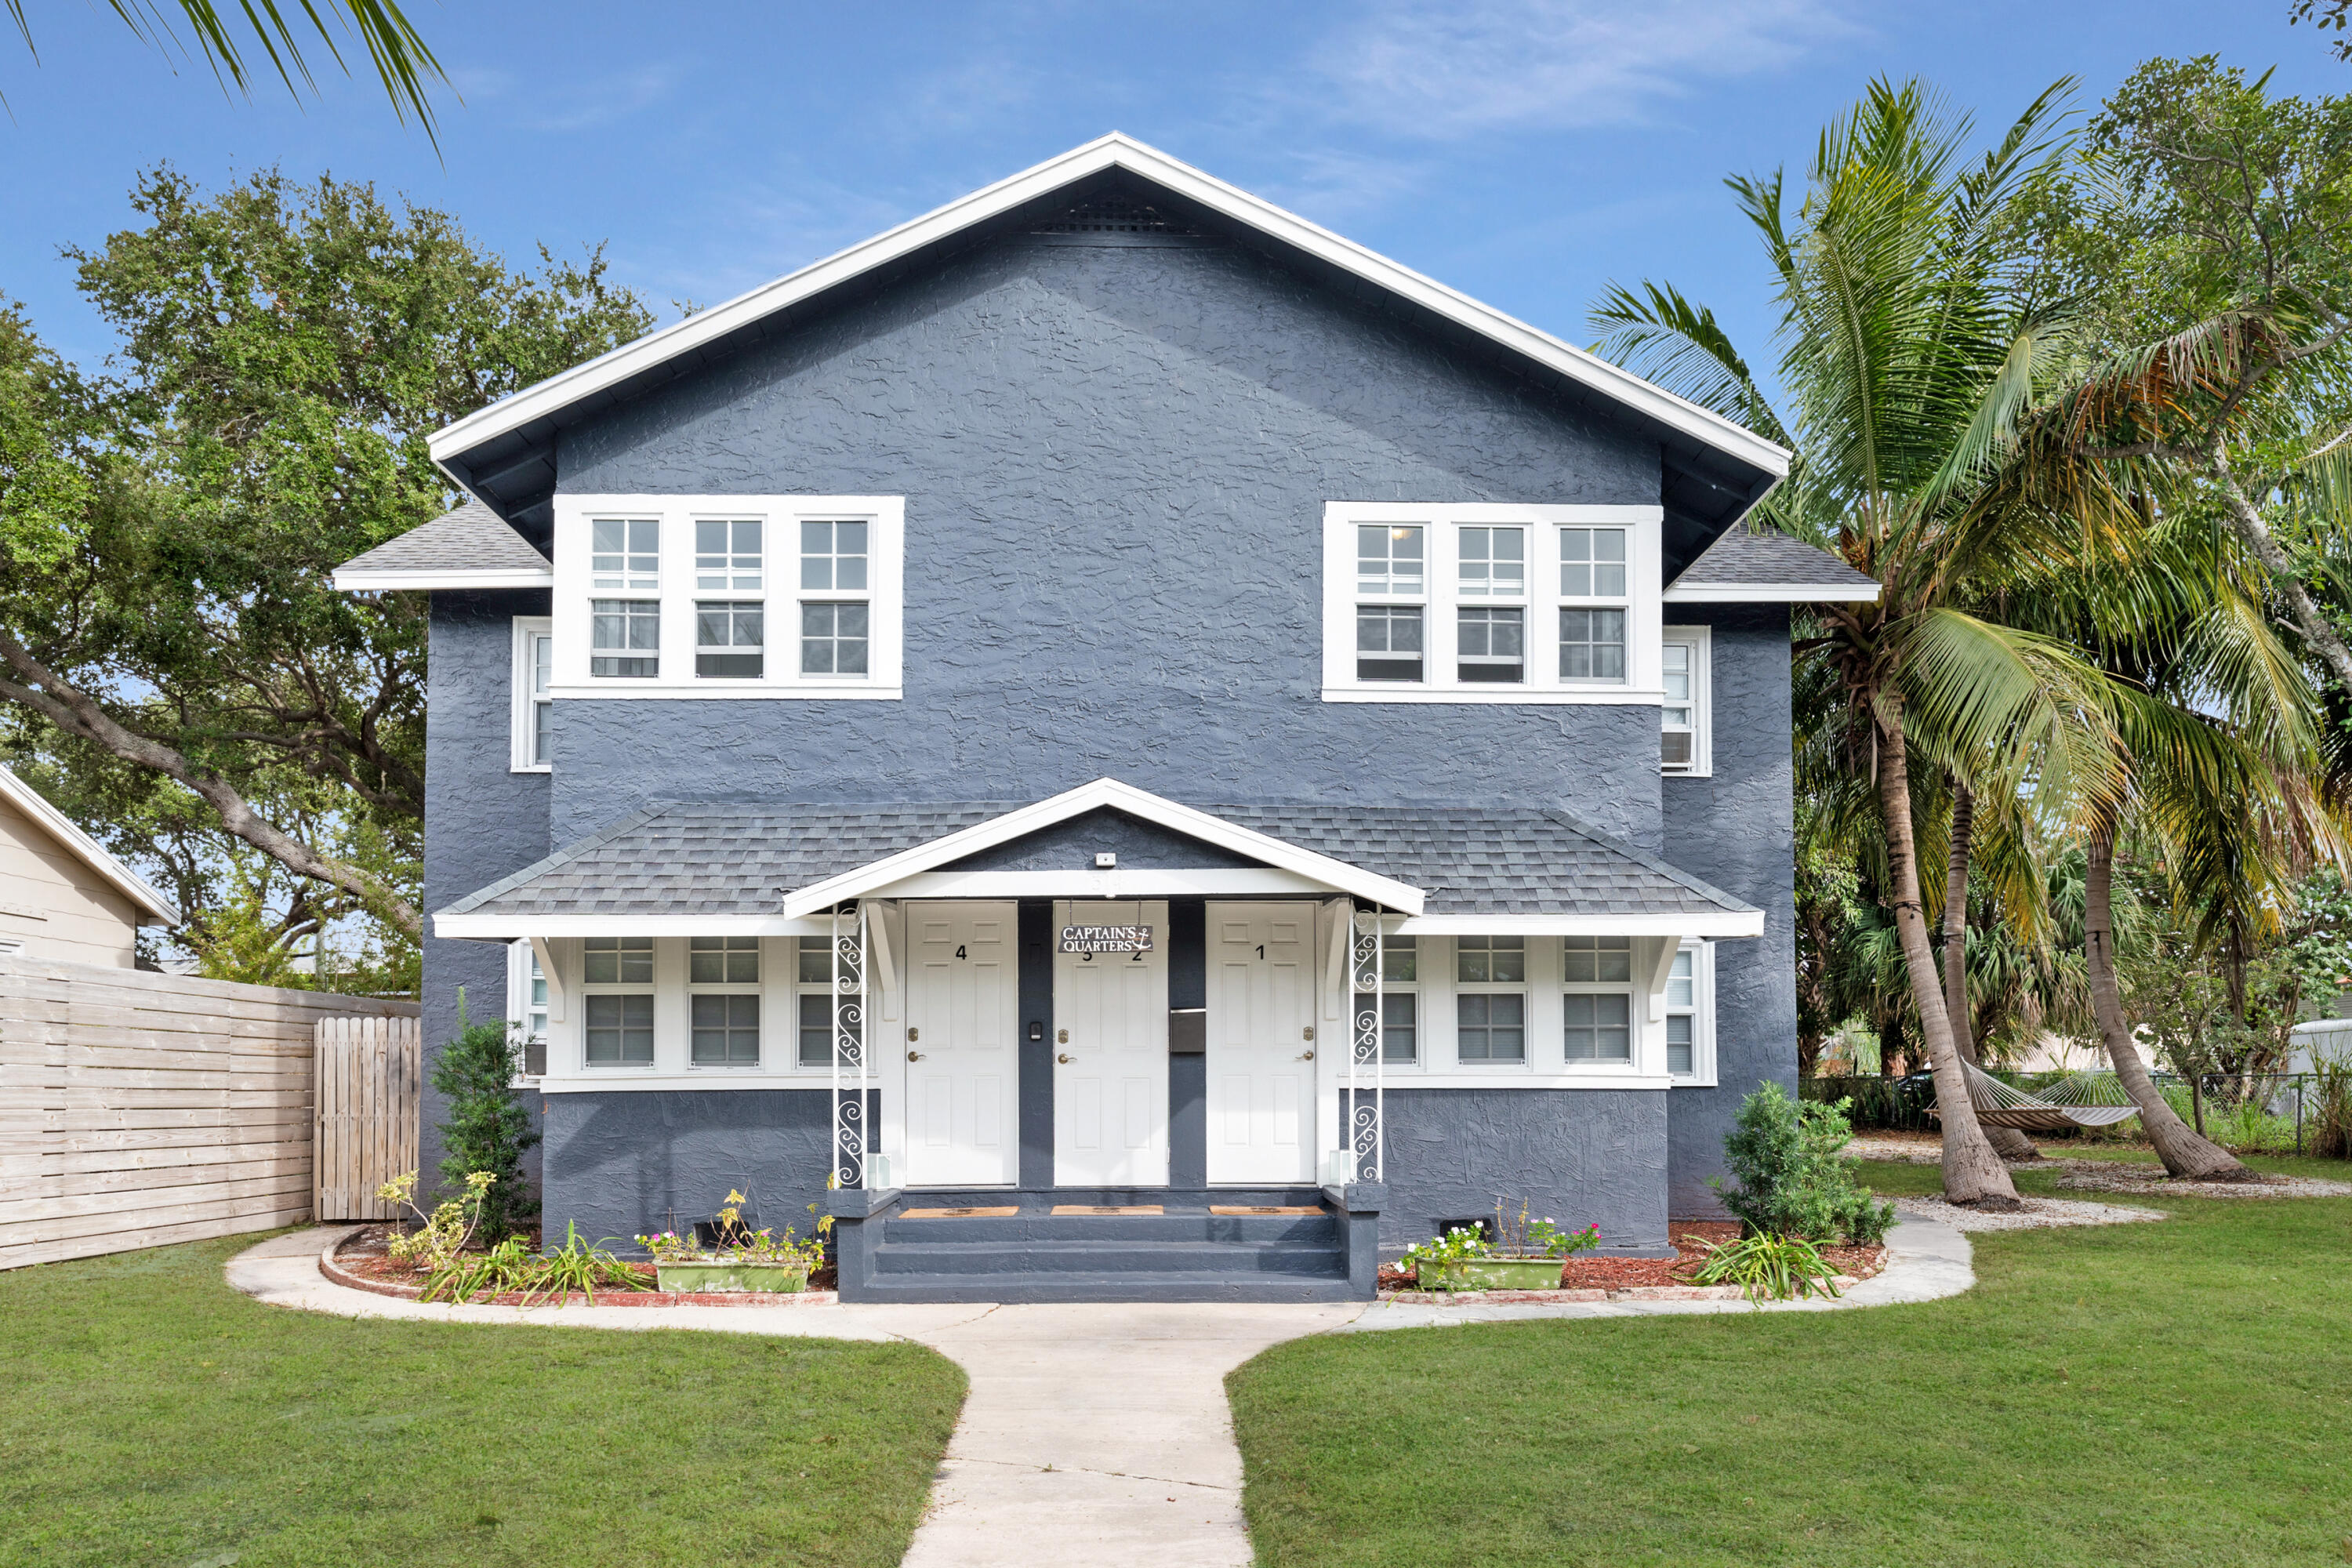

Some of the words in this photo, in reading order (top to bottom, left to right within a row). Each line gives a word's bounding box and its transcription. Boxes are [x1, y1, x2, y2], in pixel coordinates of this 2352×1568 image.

[1062, 926, 1136, 940] CAPTAIN'S
[956, 944, 967, 960] 4
[1063, 940, 1132, 953] QUARTERS
[1255, 944, 1264, 960] 1
